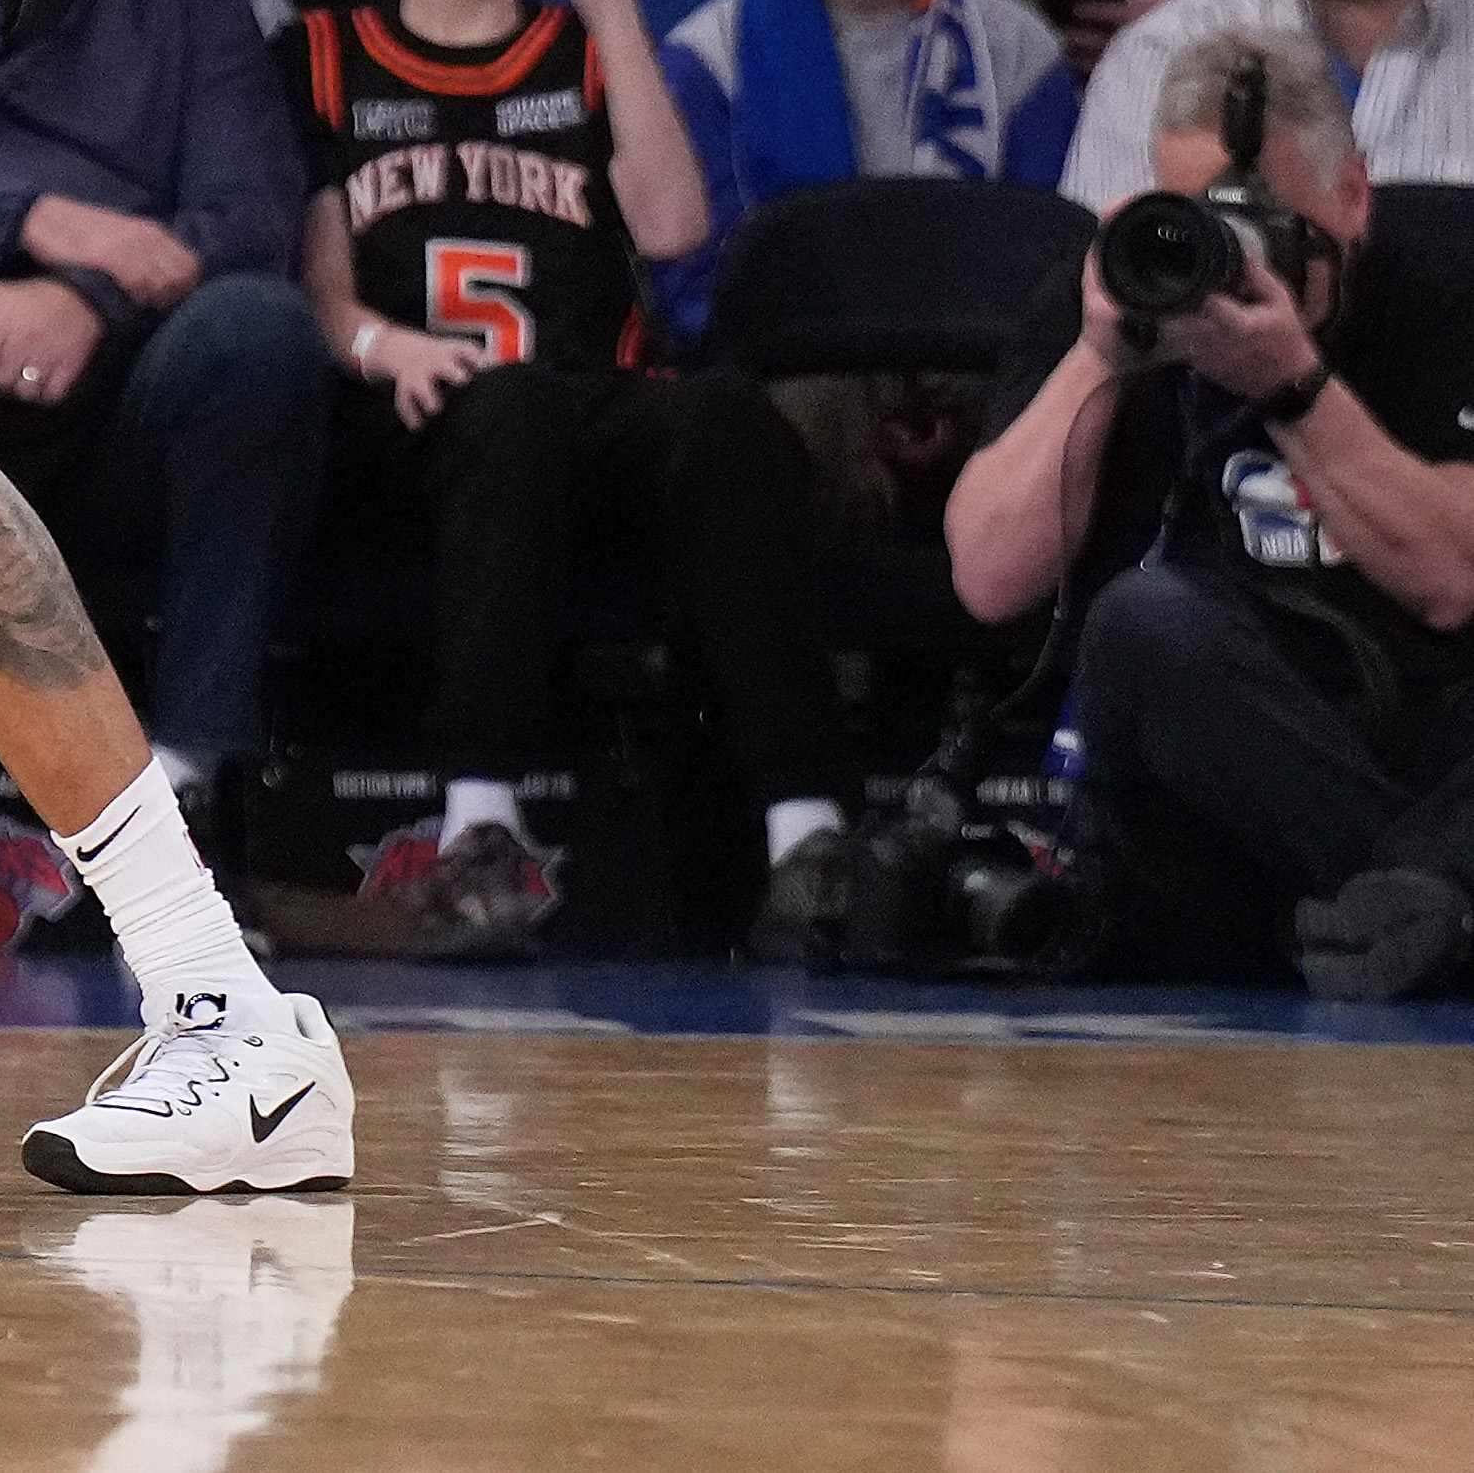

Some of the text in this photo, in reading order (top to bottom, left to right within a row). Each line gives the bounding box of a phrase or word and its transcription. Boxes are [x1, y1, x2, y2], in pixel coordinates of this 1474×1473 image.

[344, 138, 593, 234] NEW YORK
[424, 237, 534, 365] 5
